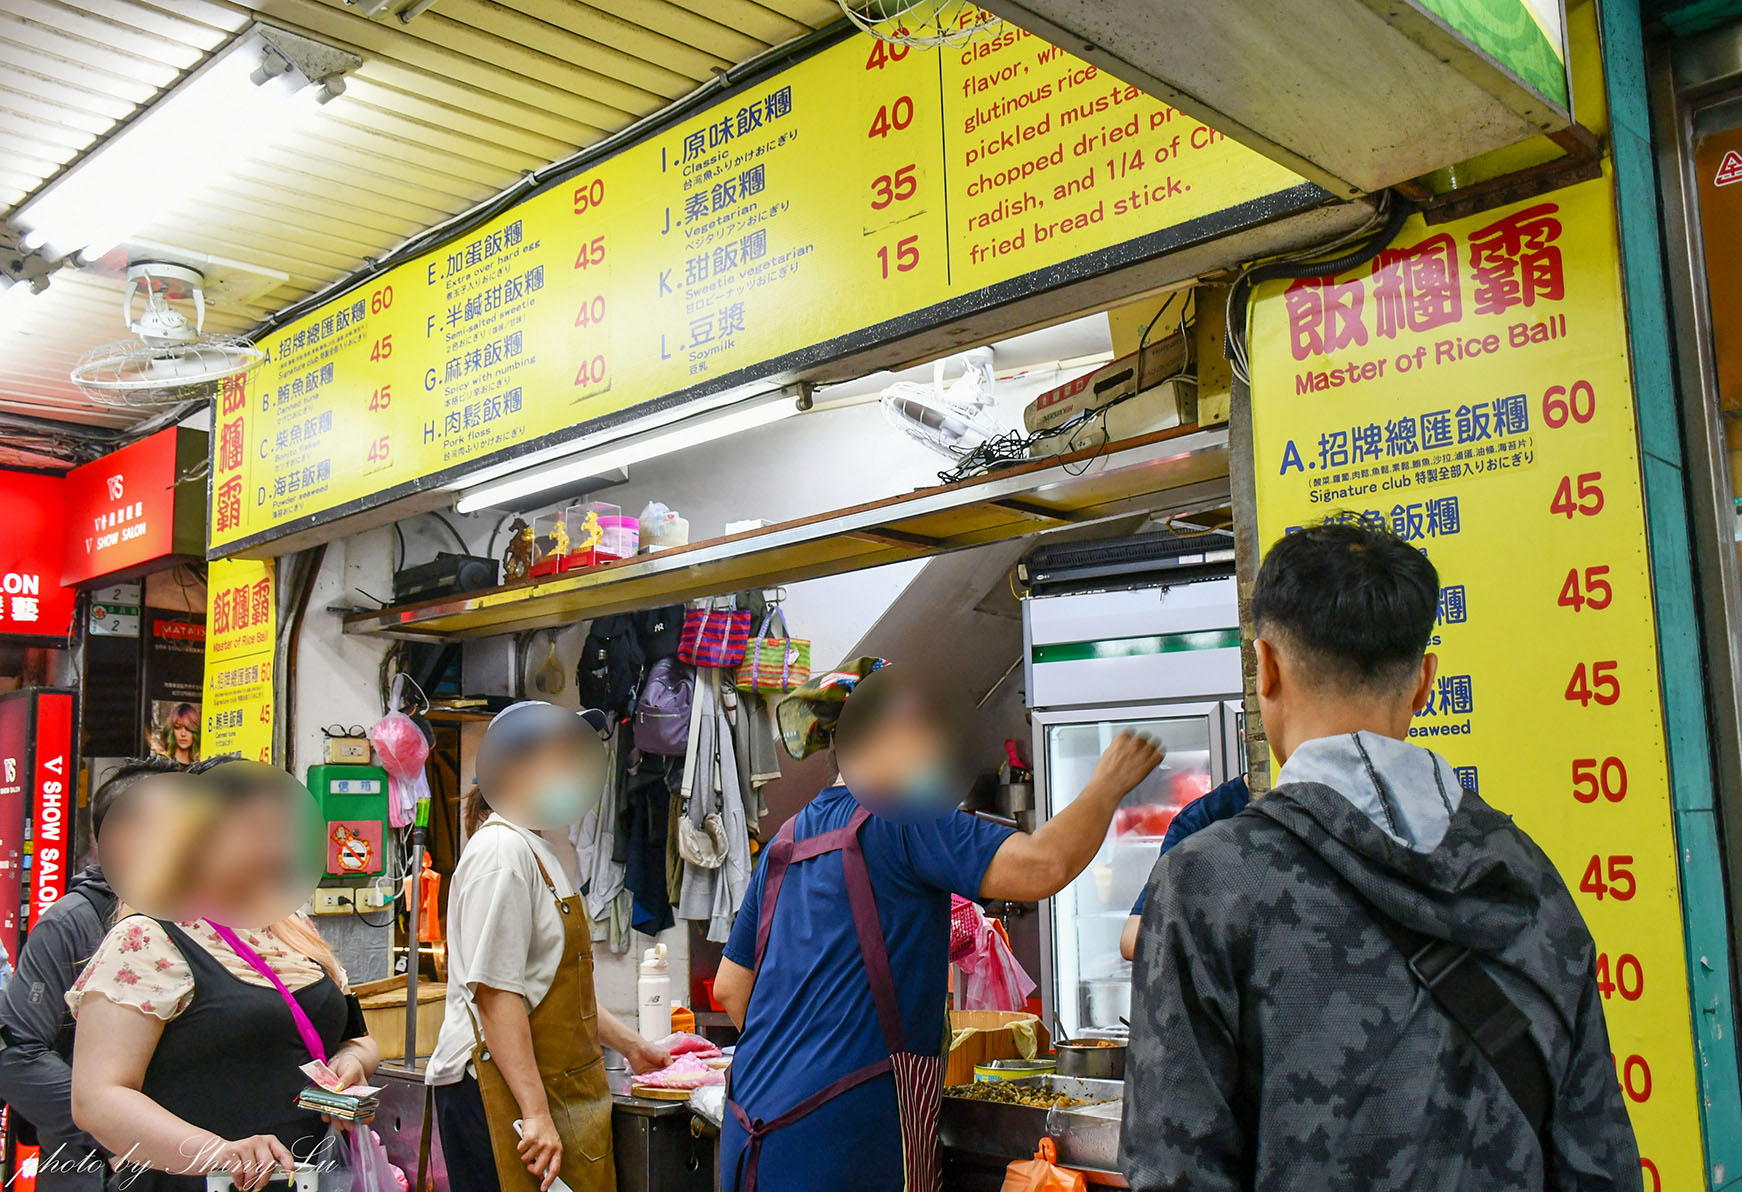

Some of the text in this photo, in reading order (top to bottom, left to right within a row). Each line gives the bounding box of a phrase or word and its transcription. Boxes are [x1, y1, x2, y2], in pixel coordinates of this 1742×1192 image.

[866, 27, 910, 70] 40
[963, 44, 1063, 98] flavor, wh
[868, 95, 914, 138] 40
[965, 65, 1097, 134] glutinous rice
[966, 85, 1145, 167] pickled musta
[683, 150, 729, 177] Classic
[967, 107, 1187, 197] chopped dried pr
[574, 178, 604, 215] 50
[871, 164, 917, 210] 35
[968, 192, 1044, 232] radish,
[1053, 167, 1095, 200] and
[1107, 149, 1145, 181] 1/4
[1154, 136, 1180, 163] of
[685, 202, 757, 239] Vegetarian
[970, 176, 1192, 264] fried bread stick.
[446, 240, 541, 289] Extra over hard egg
[574, 235, 606, 271] 45
[686, 244, 814, 300] Sweetie vegetarian
[877, 235, 919, 279] 15
[371, 285, 393, 315] 60
[446, 298, 535, 342] Semi-salted sweetie
[574, 295, 606, 329] 40
[370, 334, 393, 363] 45
[689, 339, 735, 362] Soymilk
[1295, 313, 1567, 396] Master of Rice Ball
[444, 356, 536, 396] Spicy with numbing
[574, 354, 606, 388] 40
[369, 384, 392, 413] 45
[1542, 380, 1596, 429] 60
[367, 436, 390, 464] 45
[443, 427, 491, 449] Pork floss
[1310, 475, 1412, 503] Signature club
[1550, 471, 1604, 520] 45
[97, 531, 119, 550] SHOW
[122, 522, 146, 542] SALON
[0, 572, 39, 595] ON
[113, 588, 121, 600] 2
[1557, 565, 1612, 612] 45
[112, 620, 120, 632] 2
[261, 662, 271, 682] 60
[1564, 660, 1620, 707] 45
[260, 704, 270, 724] 45
[1407, 719, 1471, 737] eaweed
[44, 755, 63, 775] V
[1572, 756, 1628, 804] 50
[41, 781, 62, 840] SHOW
[1579, 854, 1636, 901] 45
[1596, 952, 1644, 1001] 40
[1611, 1052, 1652, 1103] 0
